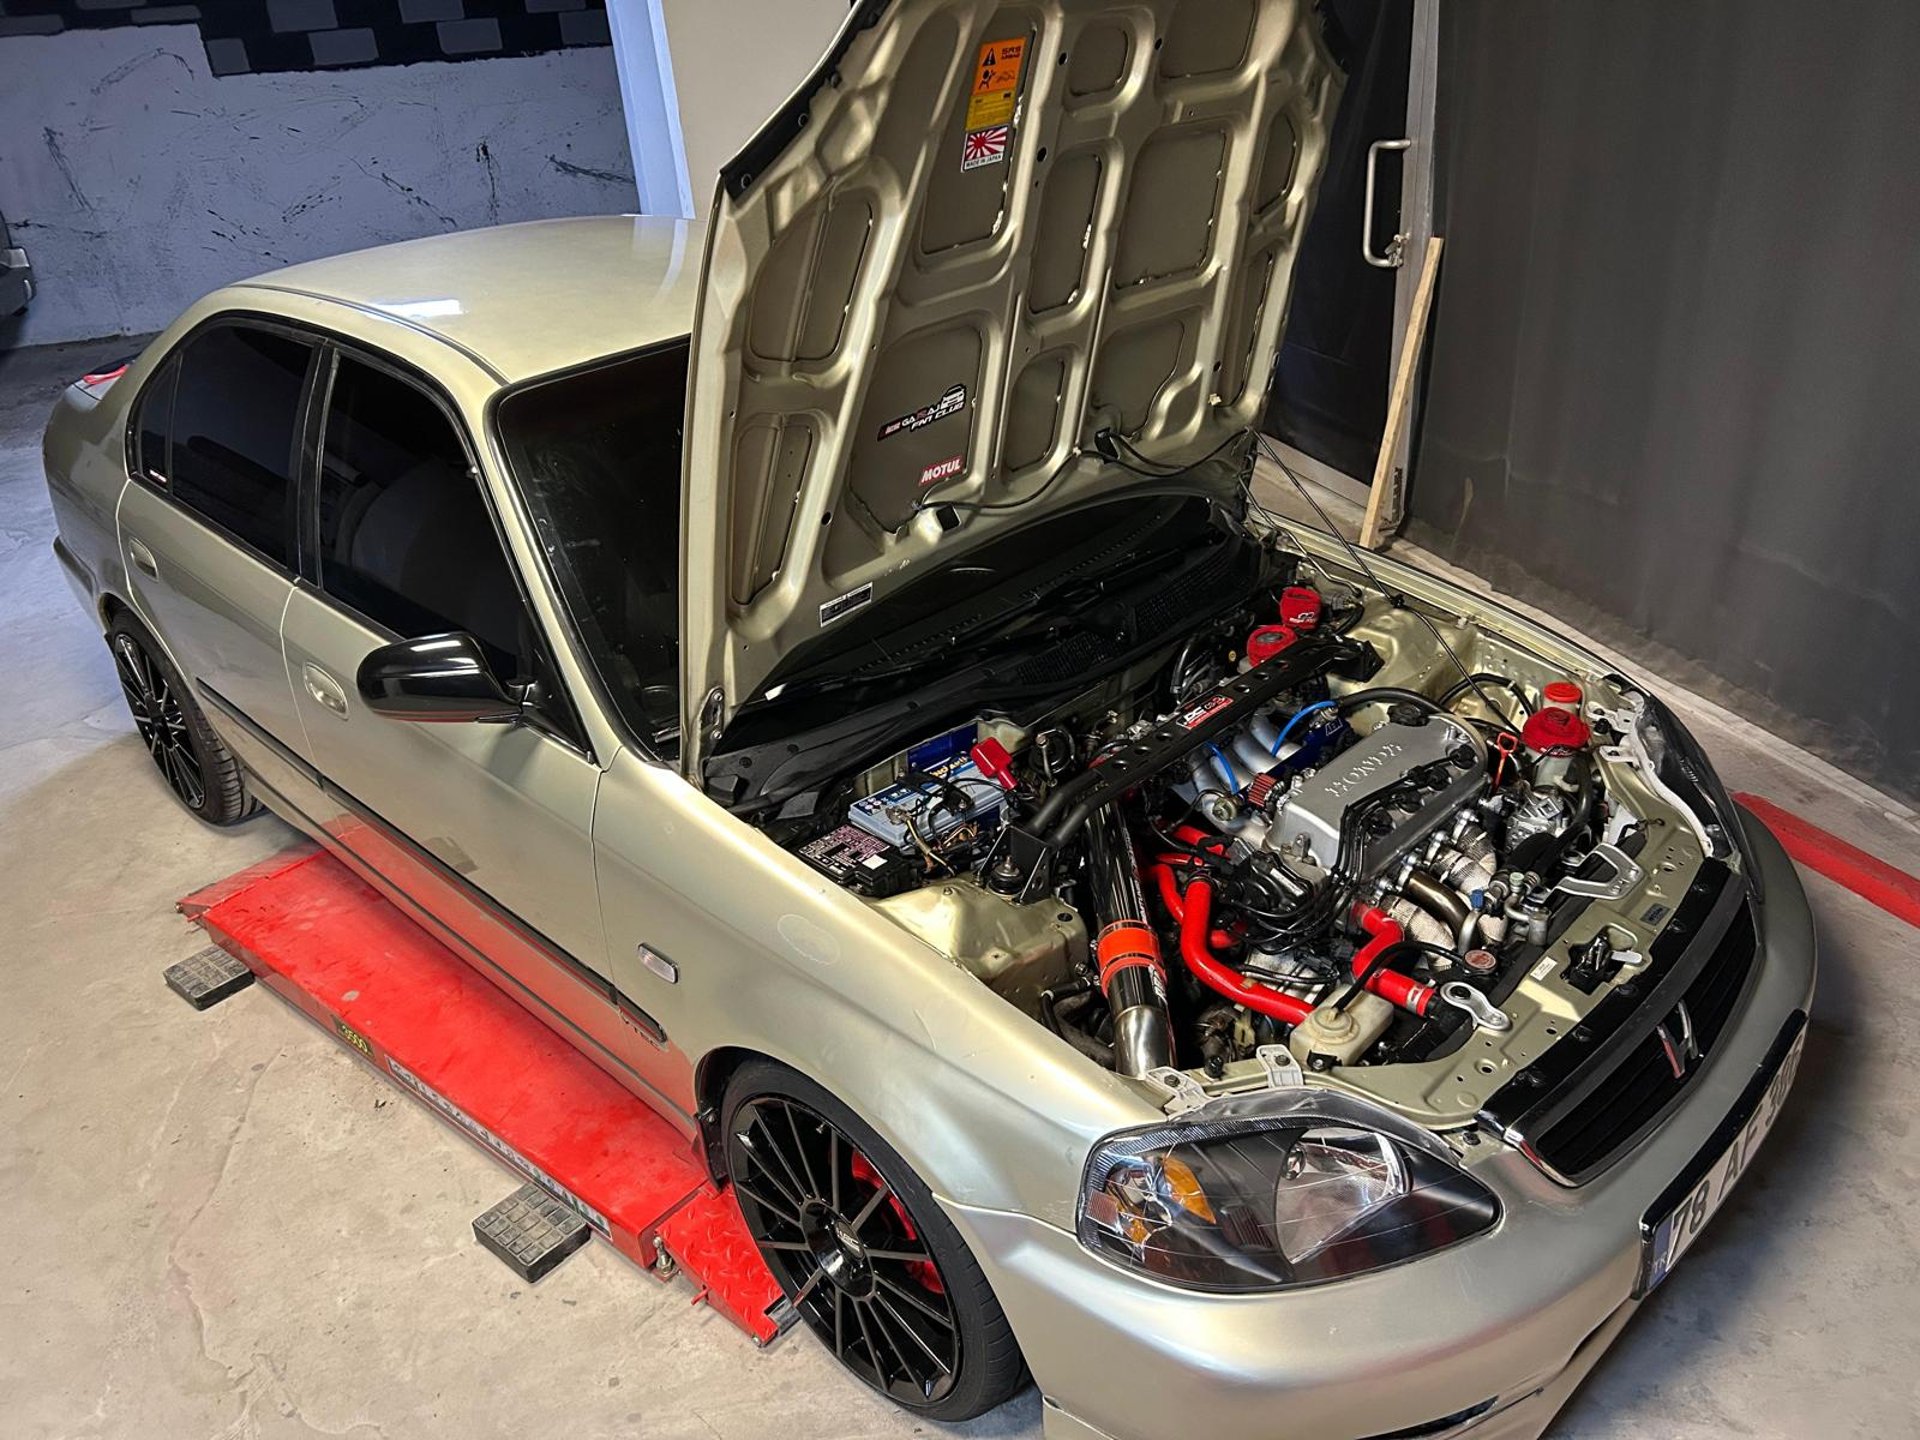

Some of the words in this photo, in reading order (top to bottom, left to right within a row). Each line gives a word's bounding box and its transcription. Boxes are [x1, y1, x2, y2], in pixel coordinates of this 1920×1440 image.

[921, 459, 961, 483] MOTUL
[1324, 743, 1403, 798] HONDA
[1668, 1180, 1711, 1266] 78
[1717, 1103, 1763, 1202] AF
